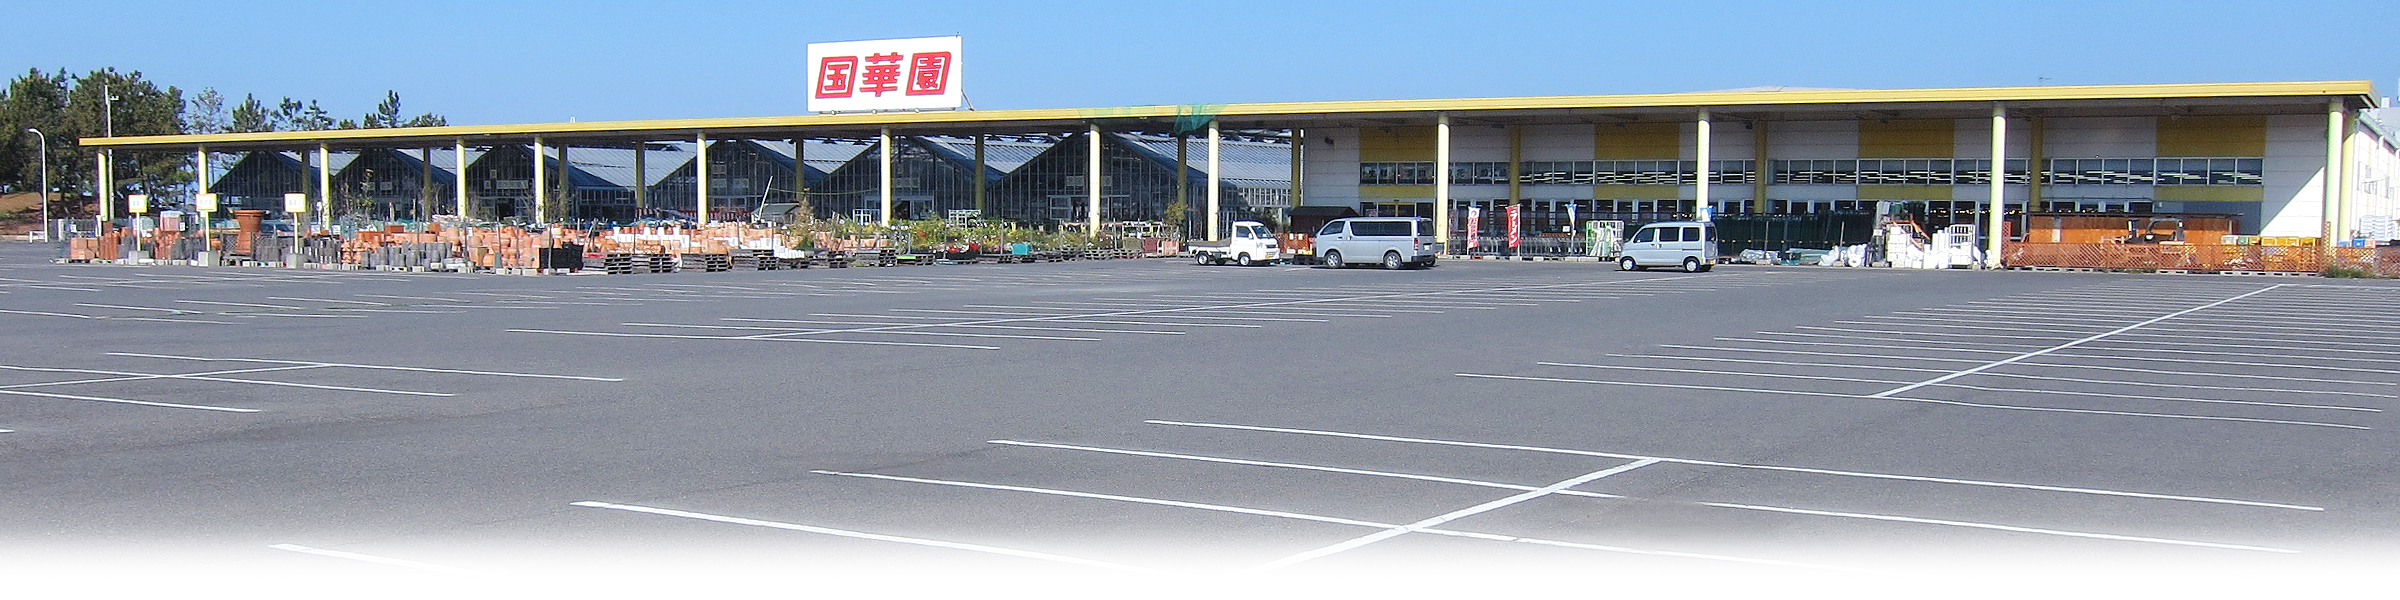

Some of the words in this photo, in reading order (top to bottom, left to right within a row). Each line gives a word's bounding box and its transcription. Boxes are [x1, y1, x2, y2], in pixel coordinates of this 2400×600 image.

[815, 51, 952, 99] 国華園
[1509, 210, 1518, 243] ラーメン
